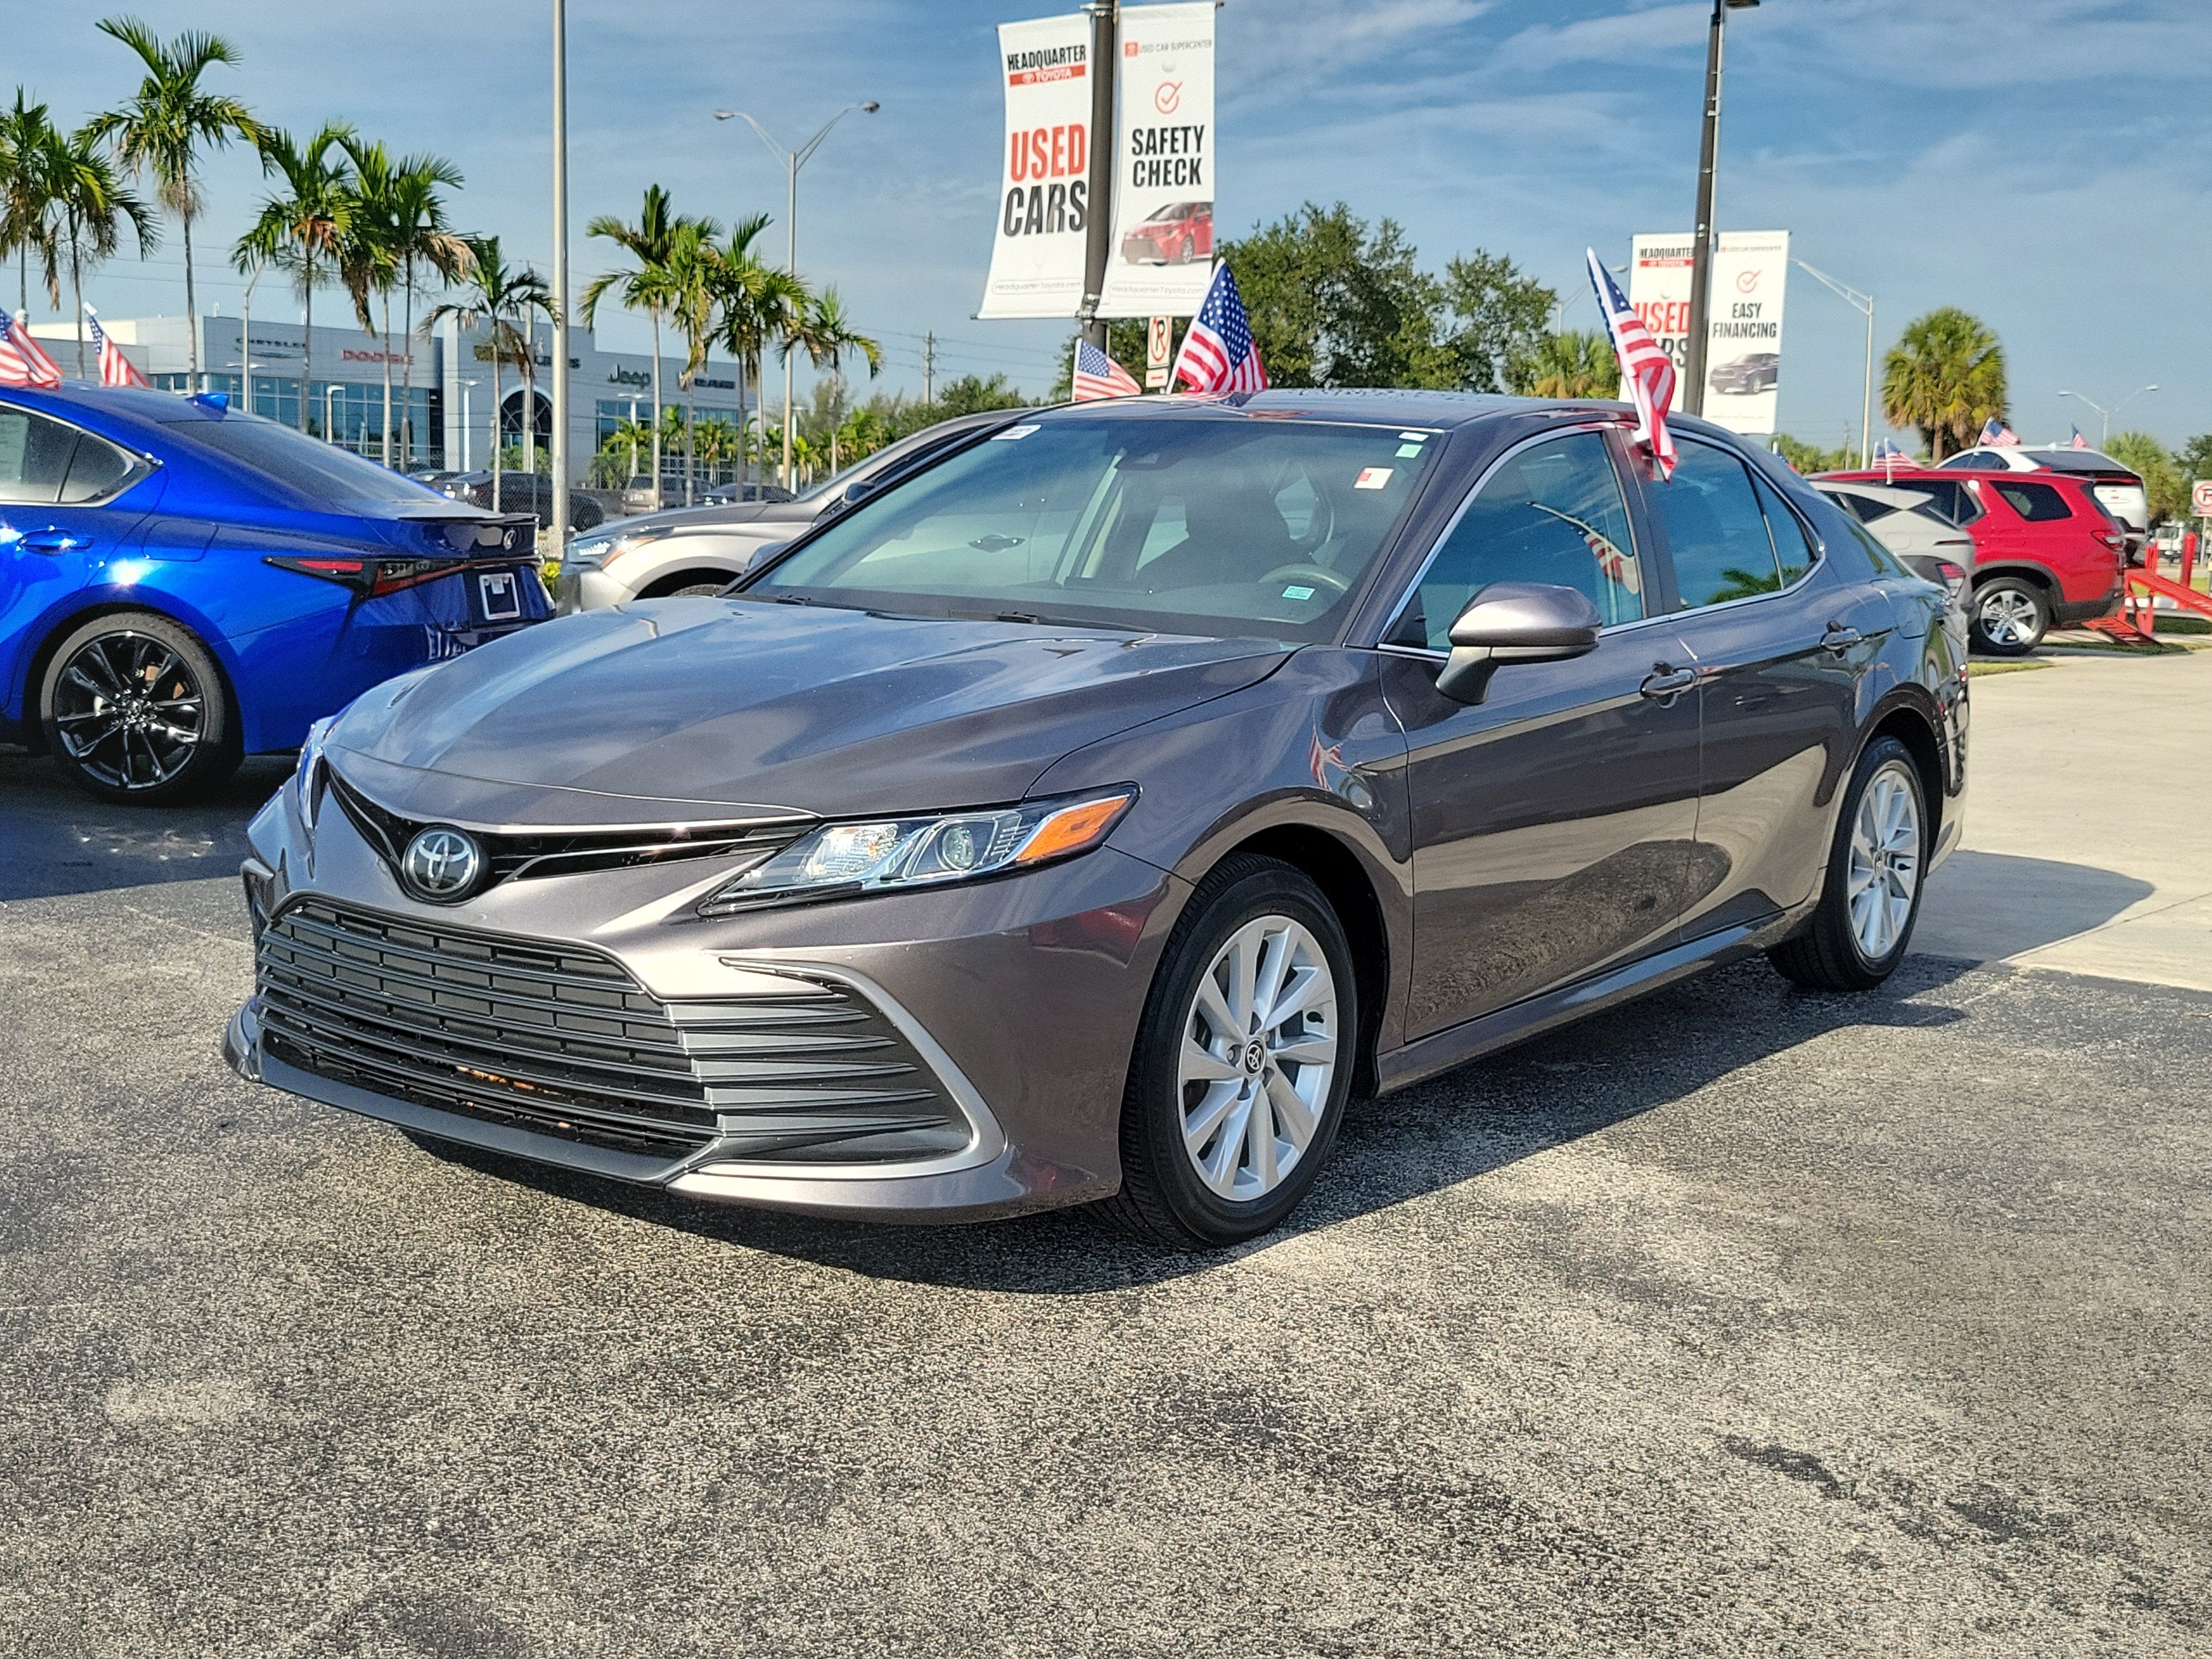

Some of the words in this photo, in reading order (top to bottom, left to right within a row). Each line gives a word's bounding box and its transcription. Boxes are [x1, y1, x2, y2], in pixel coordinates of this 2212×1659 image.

[1007, 44, 1086, 71] HEADQUARTER
[1036, 67, 1072, 83] TOYOTA
[1011, 124, 1086, 182] USED
[1132, 125, 1205, 156] SAFETY
[1132, 158, 1202, 188] CHECK
[1003, 180, 1087, 236] CARS
[1732, 302, 1762, 319] EASY
[1713, 322, 1777, 338] FINANCING
[608, 363, 651, 391] Jeep
